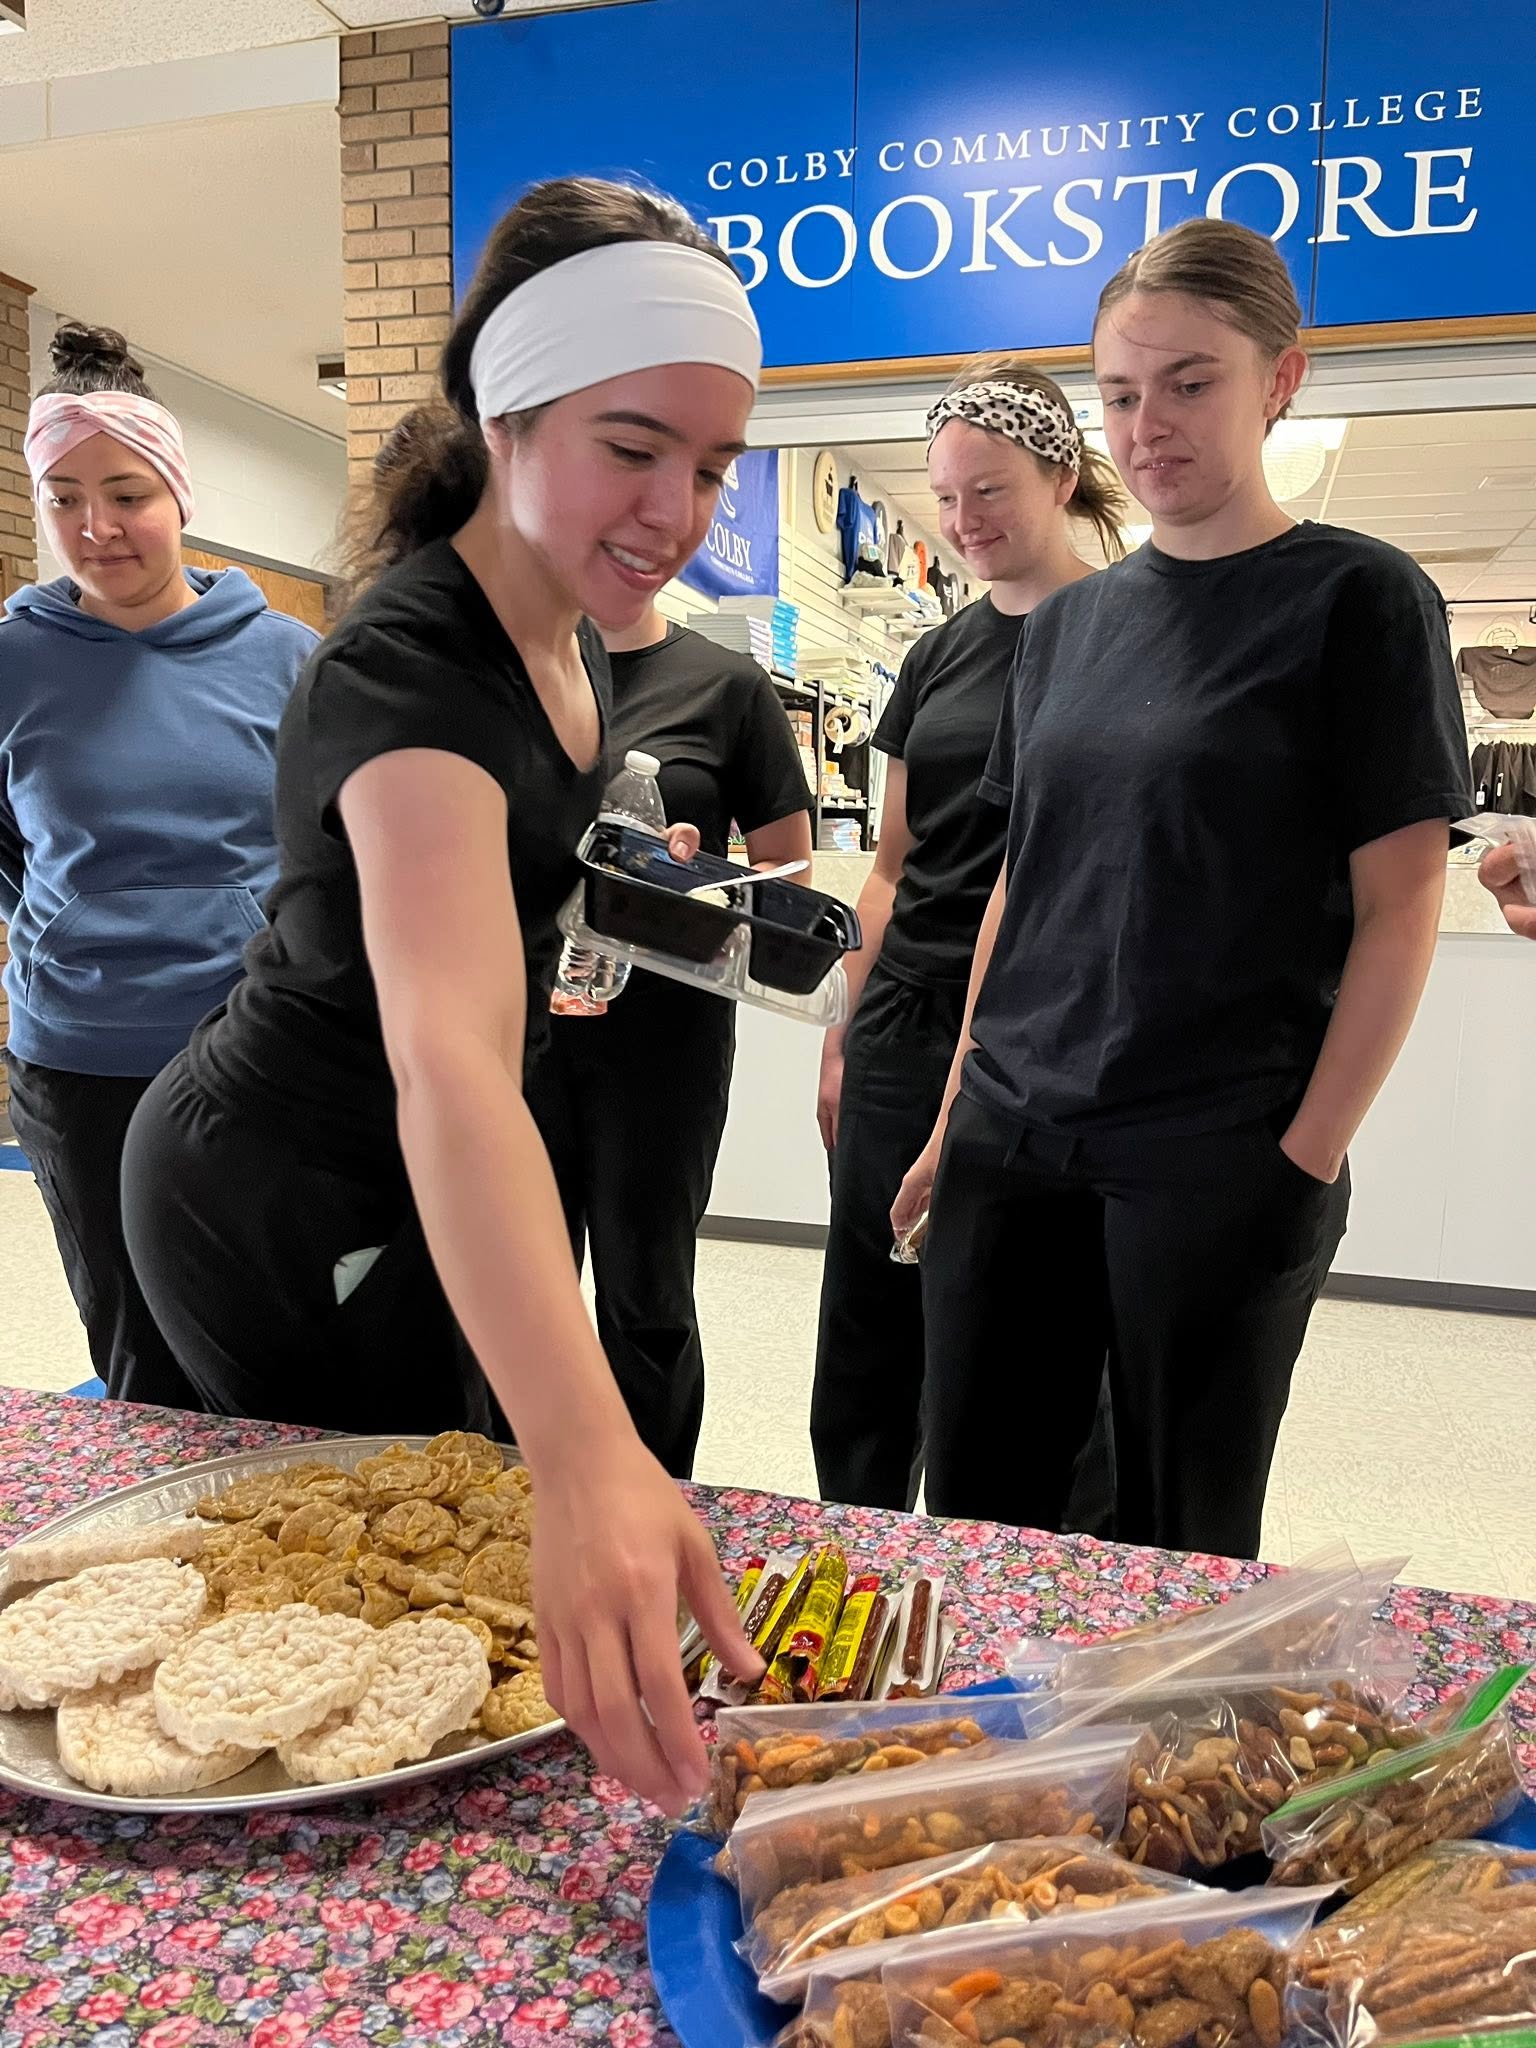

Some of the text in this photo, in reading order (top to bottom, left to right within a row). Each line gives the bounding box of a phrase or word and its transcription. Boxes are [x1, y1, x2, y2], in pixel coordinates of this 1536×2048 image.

[707, 87, 1483, 191] COLBY COMMUNITY COLLEGE
[707, 146, 1480, 290] BOOKSTORE
